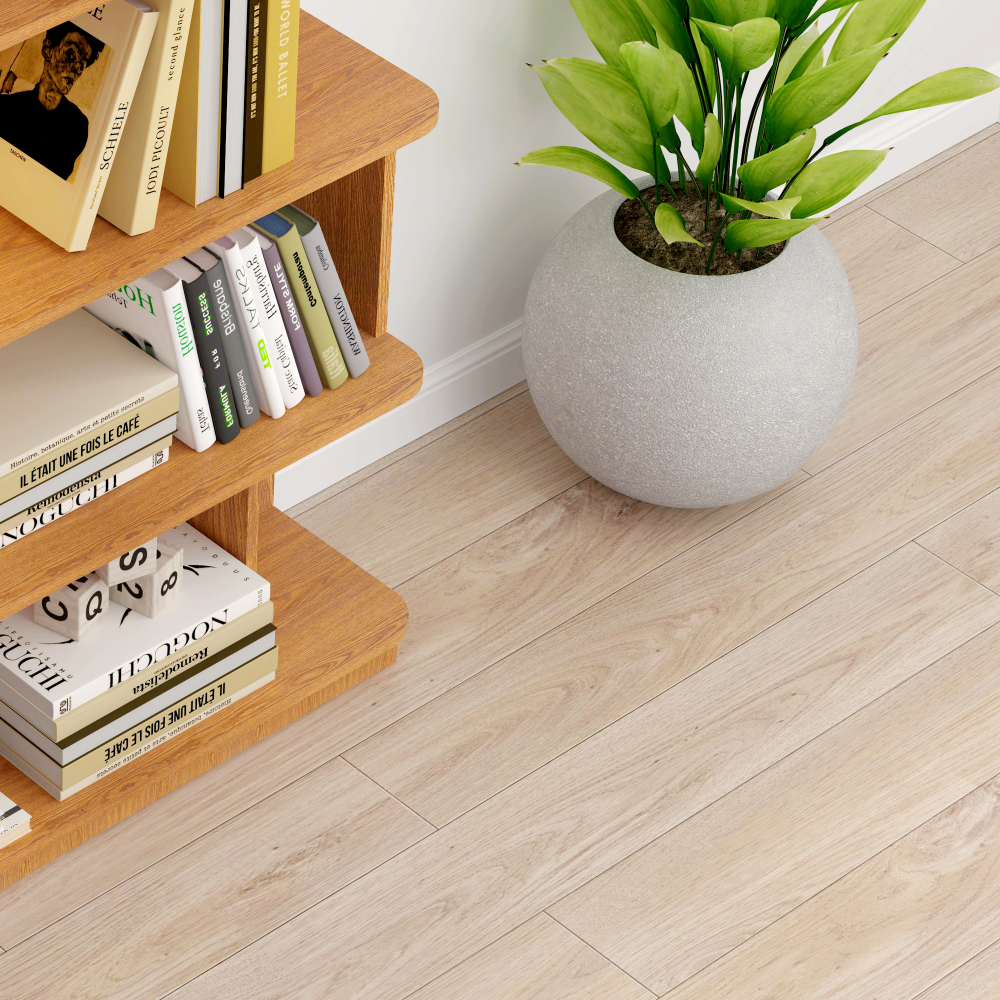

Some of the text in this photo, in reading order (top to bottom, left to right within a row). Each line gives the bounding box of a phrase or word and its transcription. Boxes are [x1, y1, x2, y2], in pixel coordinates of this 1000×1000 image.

[167, 7, 185, 81] second glance
[277, 51, 289, 99] BALLET
[99, 101, 129, 171] SCHIELE
[145, 105, 170, 195] JODI PICOULT
[10, 451, 40, 470] Histoire,
[41, 433, 76, 454] botanique,
[76, 424, 91, 436] arts
[92, 419, 99, 427] et
[100, 409, 120, 424] petits
[20, 413, 140, 488] IL ÉTAIT UNE FOIS LE CAFÉ
[1, 474, 117, 547] NOGUCHI
[119, 547, 148, 571] S
[160, 571, 178, 597] 8
[85, 590, 102, 621] Q
[108, 608, 229, 690] NOGUCHI
[132, 646, 209, 696] Remodelista
[104, 682, 226, 763] IL ÉTAIT UNE FOIS LE CAFÉ
[143, 743, 151, 752] et
[152, 735, 167, 747] arts
[123, 748, 142, 764] petits
